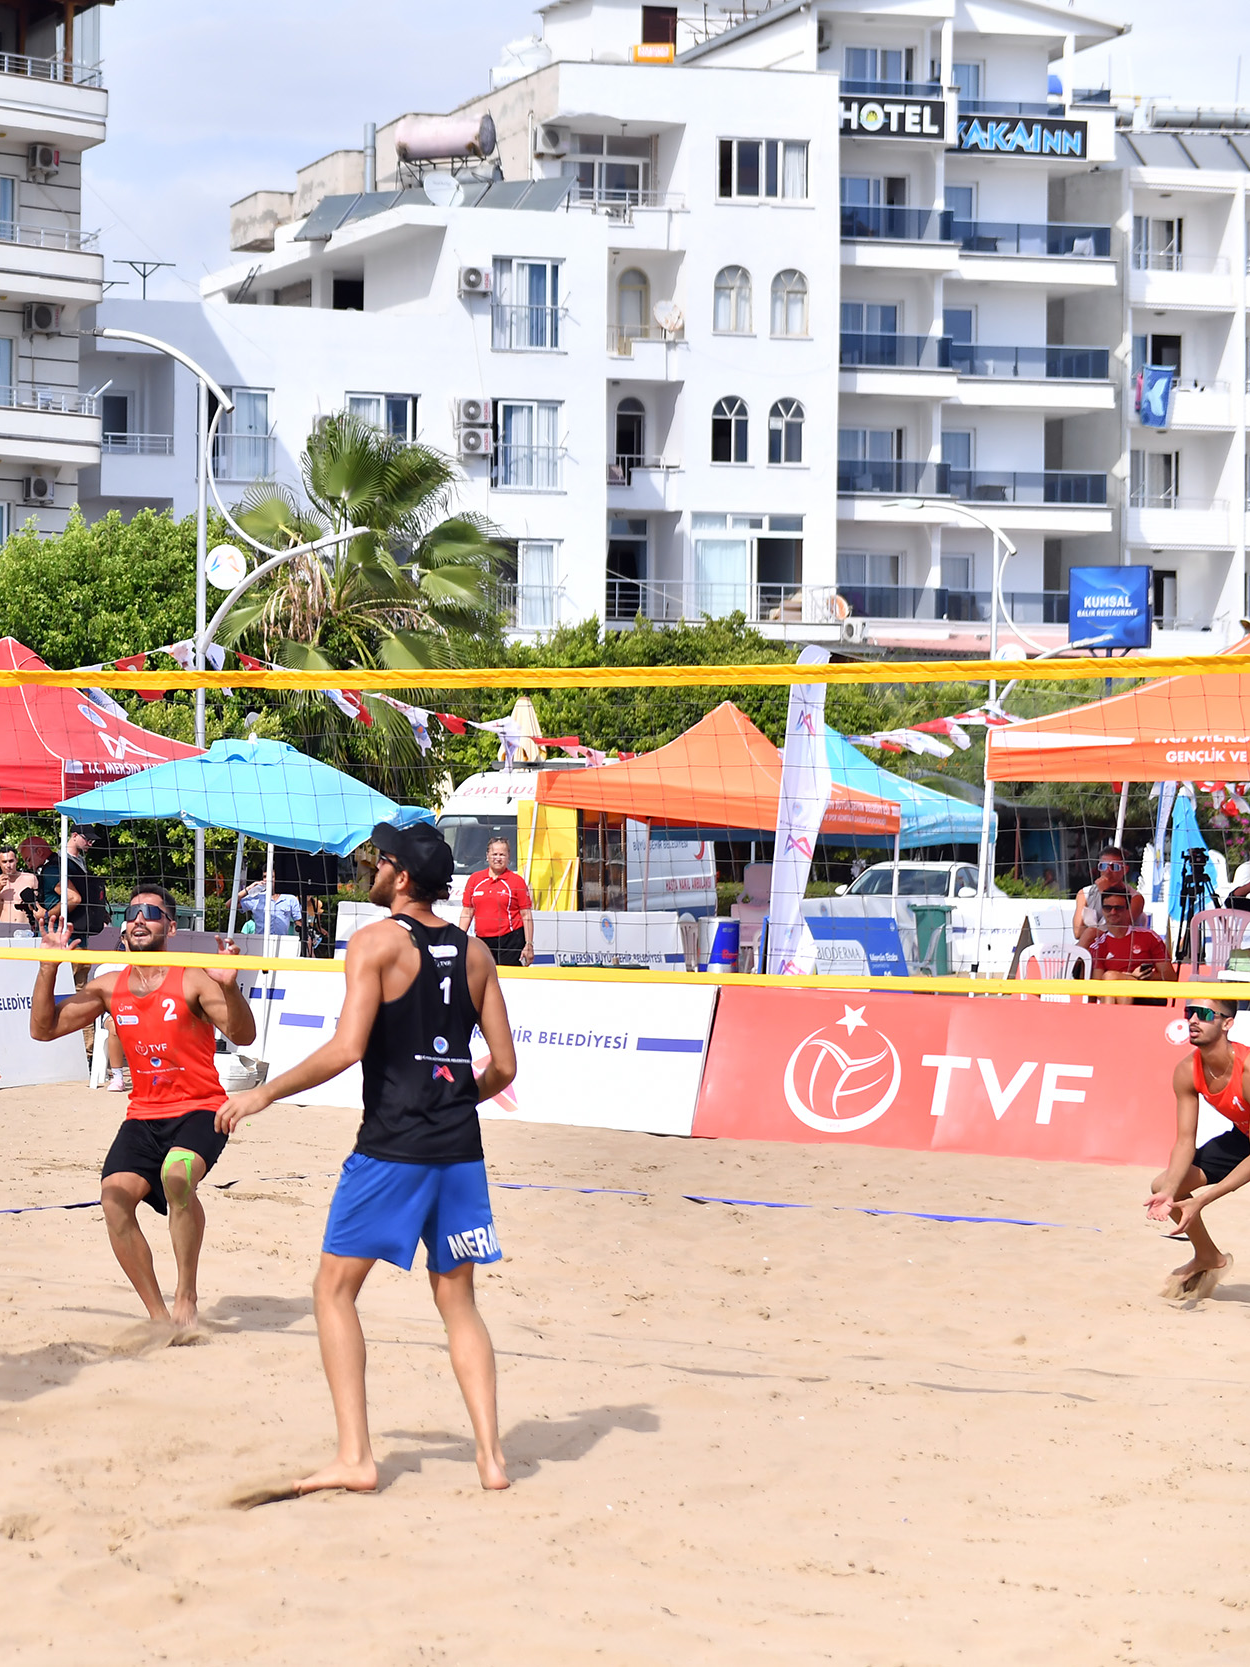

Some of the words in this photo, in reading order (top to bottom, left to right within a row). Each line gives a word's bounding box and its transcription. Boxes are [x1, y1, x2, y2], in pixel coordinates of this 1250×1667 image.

[840, 101, 940, 135] HOTEL
[1083, 595, 1132, 608] KUMSAL
[1096, 607, 1138, 617] RESTAURANT
[1165, 746, 1225, 765] GENÇLİK
[1229, 750, 1247, 763] VE
[85, 761, 105, 775] T.C.
[816, 946, 862, 960] BIODERMA
[439, 976, 452, 1005] 1
[161, 998, 178, 1022] 2
[149, 1043, 167, 1053] TVF
[537, 1030, 629, 1050] BELEDİYESİ
[921, 1054, 1094, 1125] TVF
